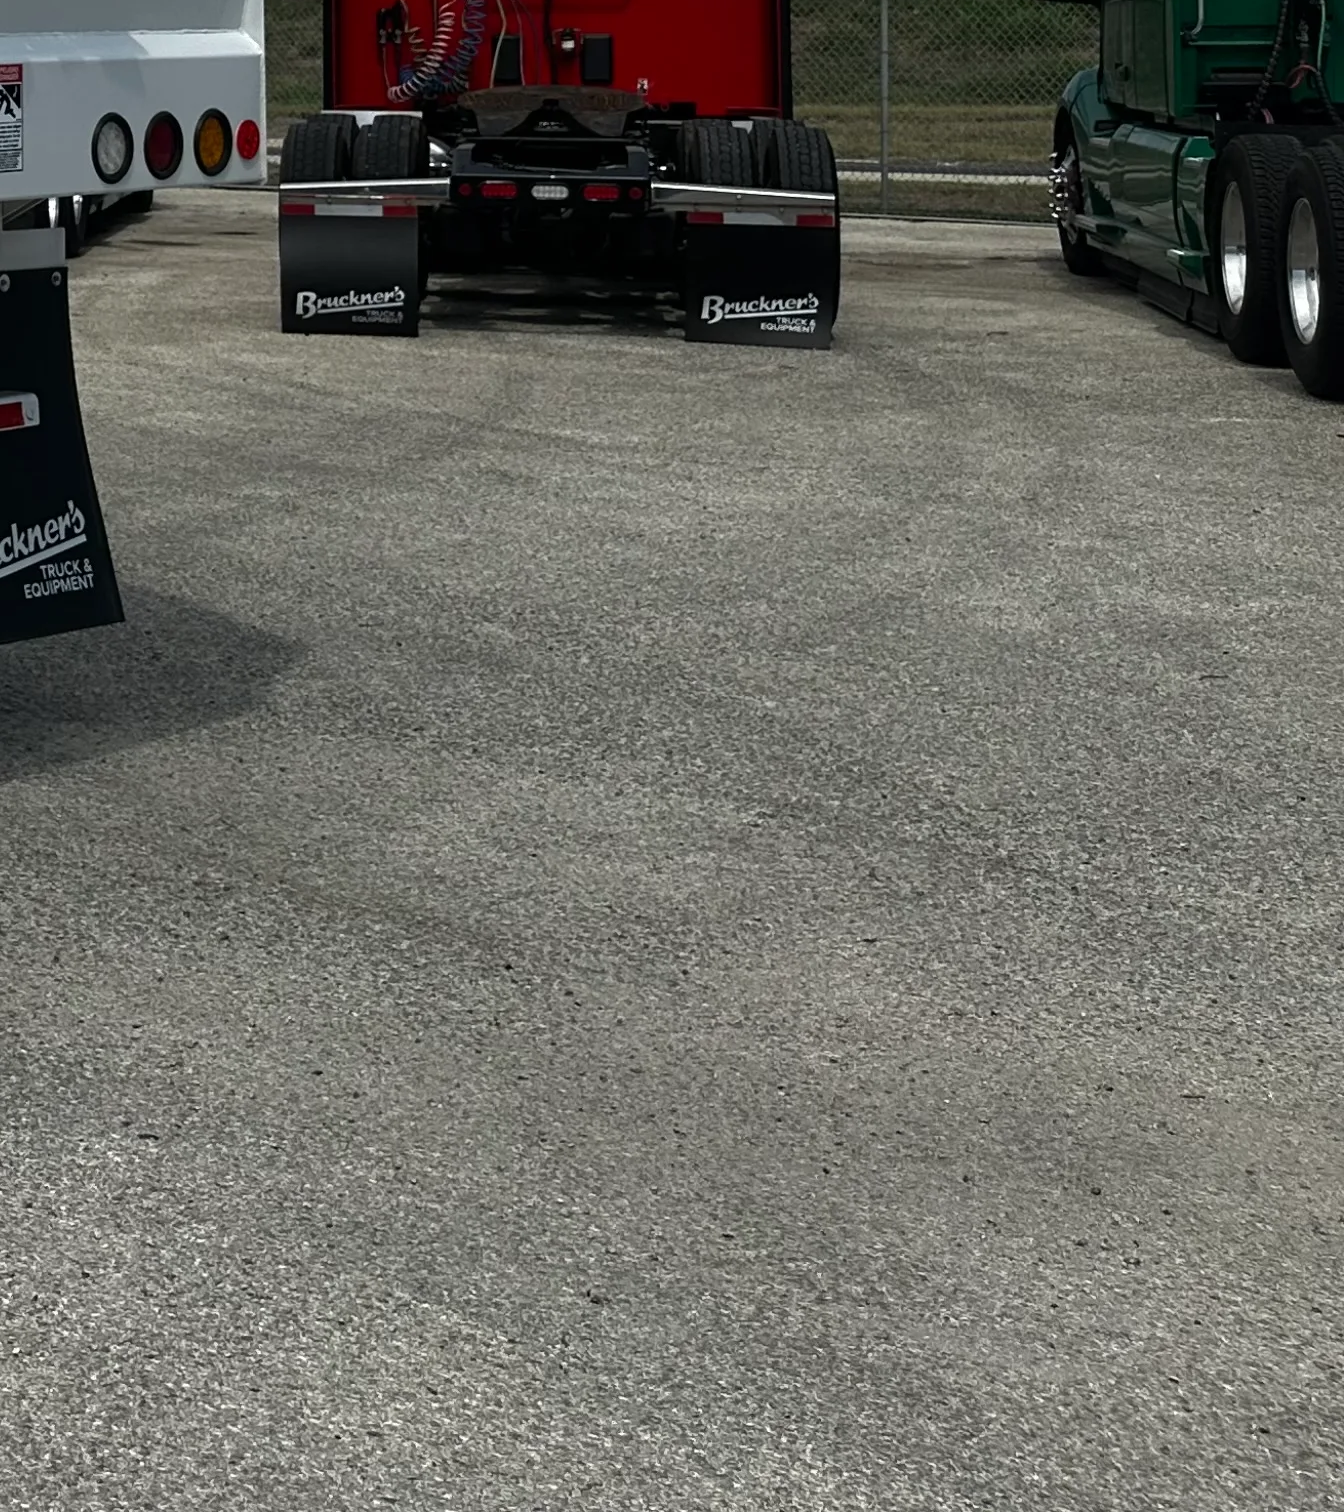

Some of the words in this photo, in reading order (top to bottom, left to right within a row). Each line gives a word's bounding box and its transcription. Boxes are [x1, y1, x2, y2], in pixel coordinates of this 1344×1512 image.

[296, 286, 405, 319] Bruckner's
[701, 293, 819, 324] Bruckner's
[39, 559, 80, 579] TRUCK
[83, 558, 93, 572] &
[23, 574, 94, 599] EQUIPMENT
